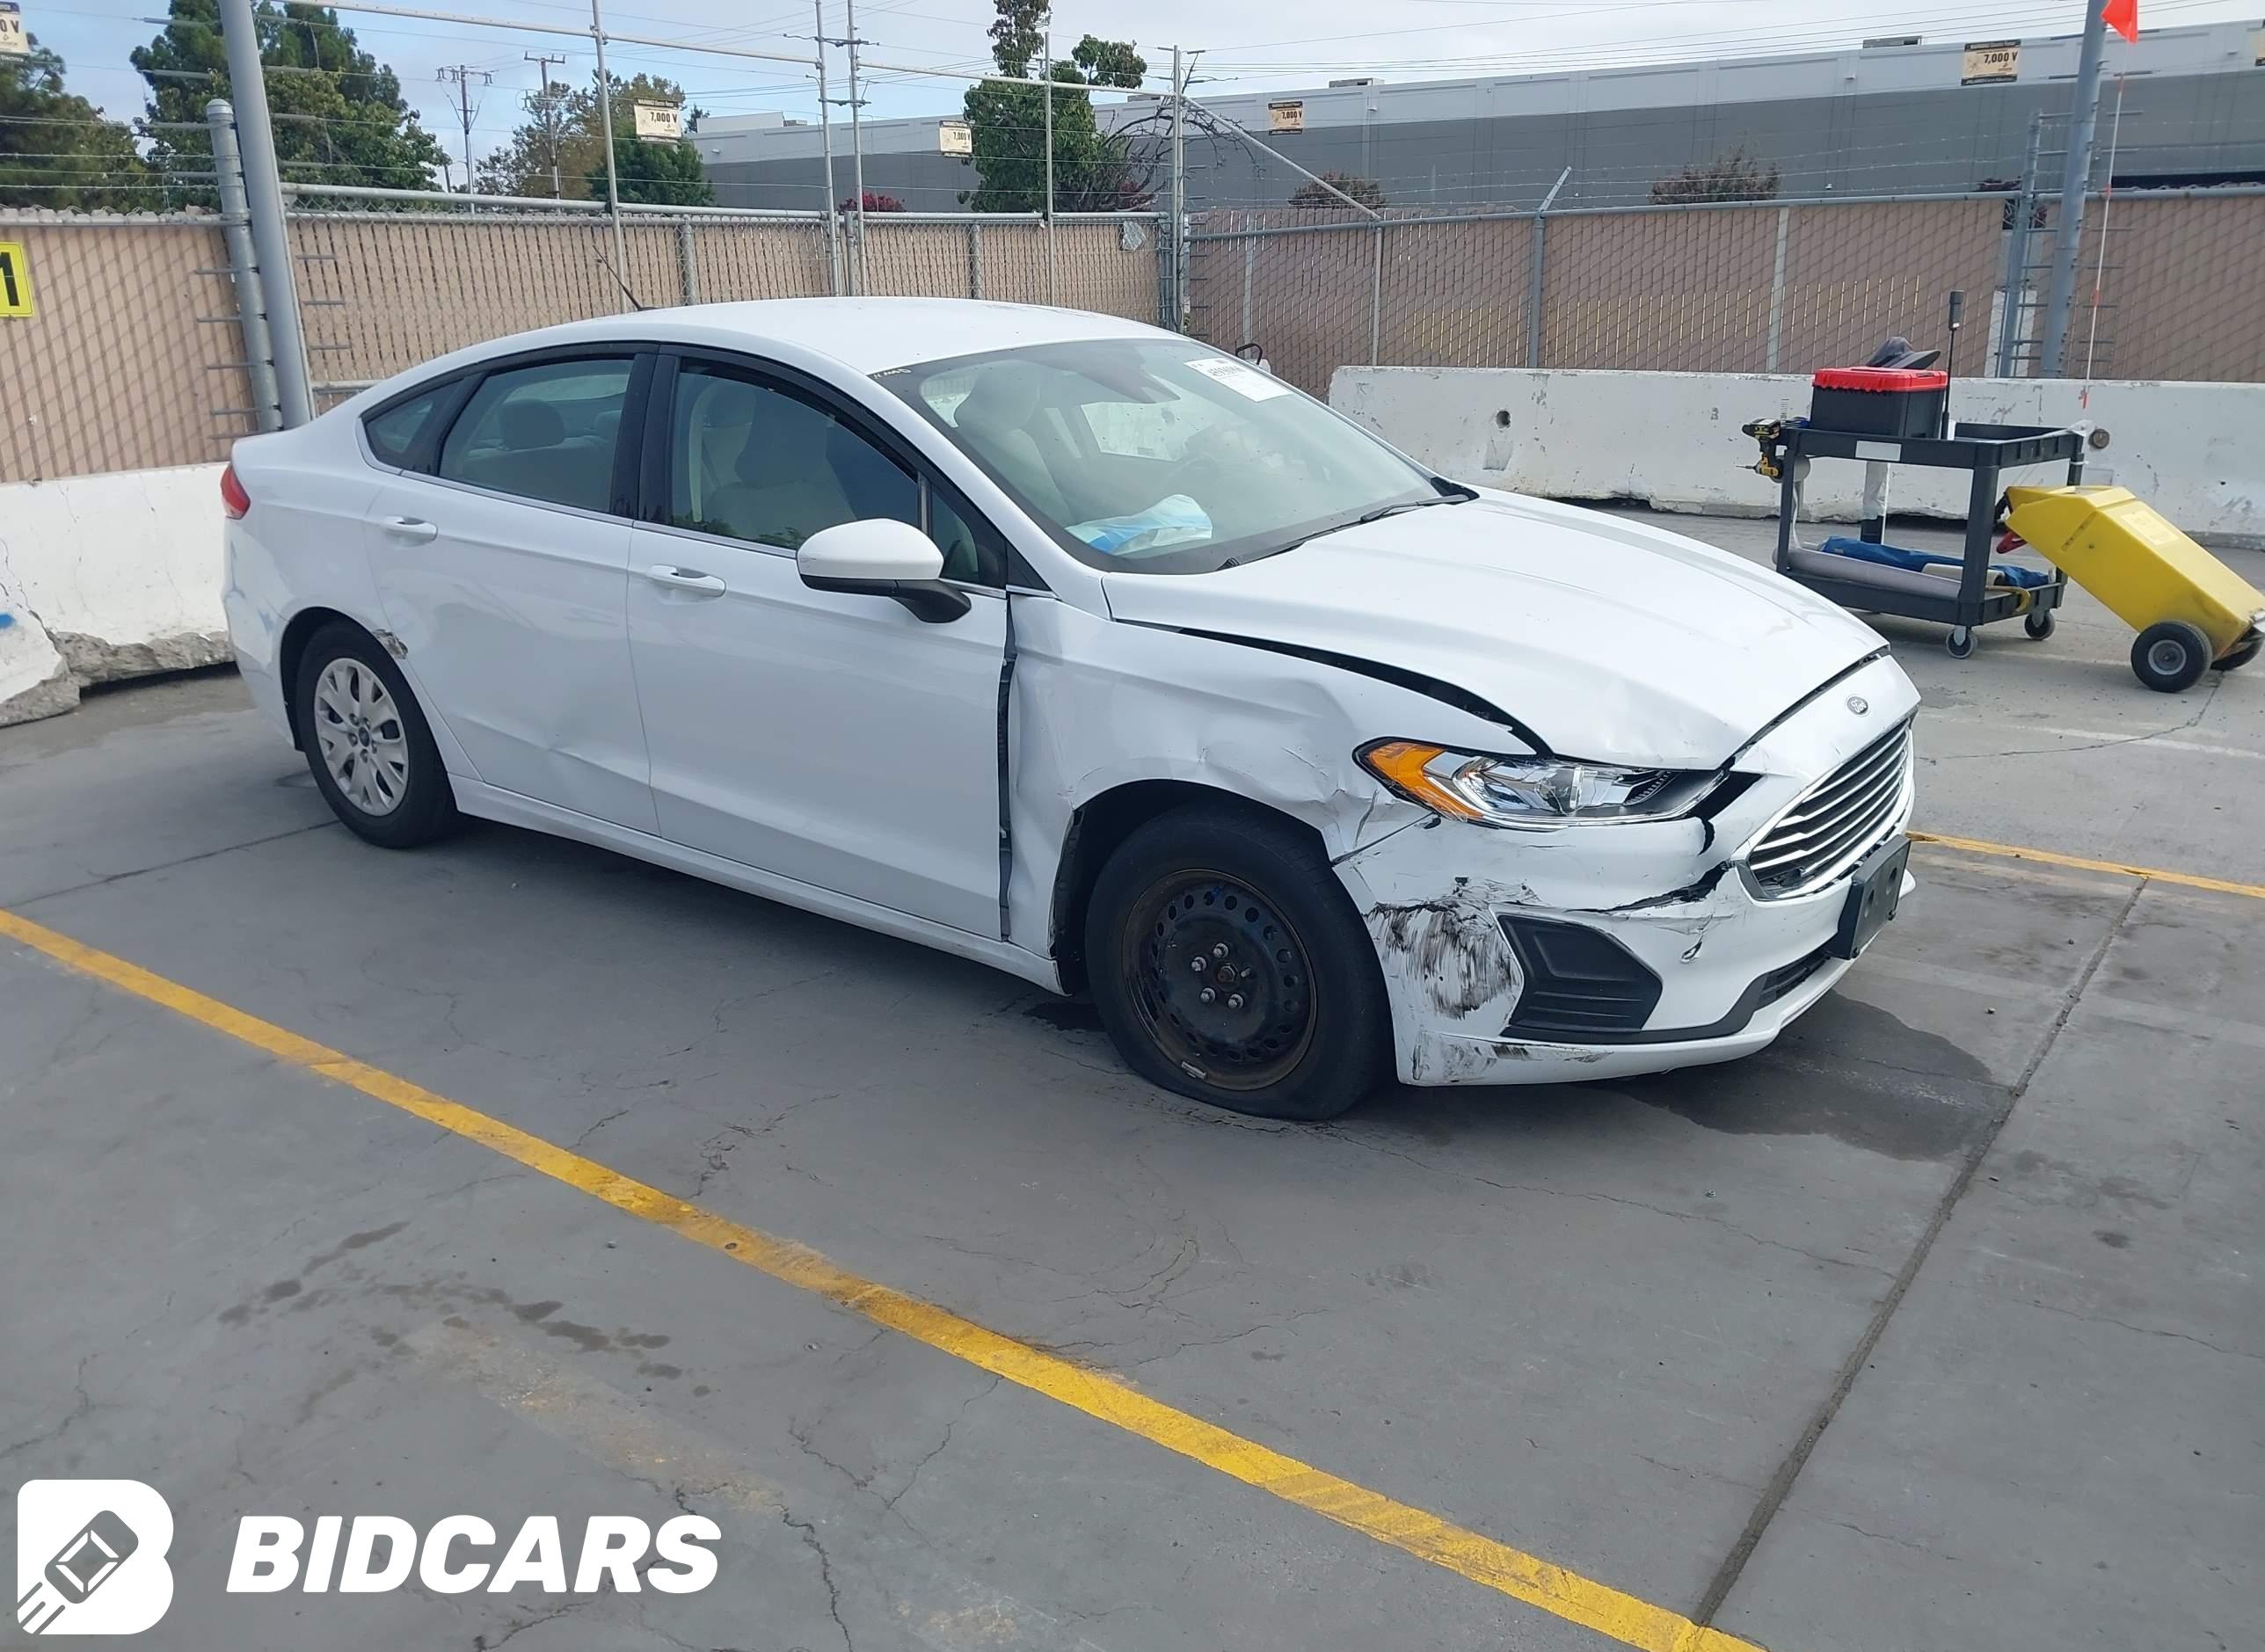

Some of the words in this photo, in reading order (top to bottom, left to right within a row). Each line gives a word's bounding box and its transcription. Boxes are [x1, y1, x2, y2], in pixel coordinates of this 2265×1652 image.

[10, 19, 19, 33] V
[1984, 52, 2009, 65] 7,000
[2012, 51, 2019, 62] V
[651, 112, 671, 123] 7,000
[672, 113, 678, 123] V
